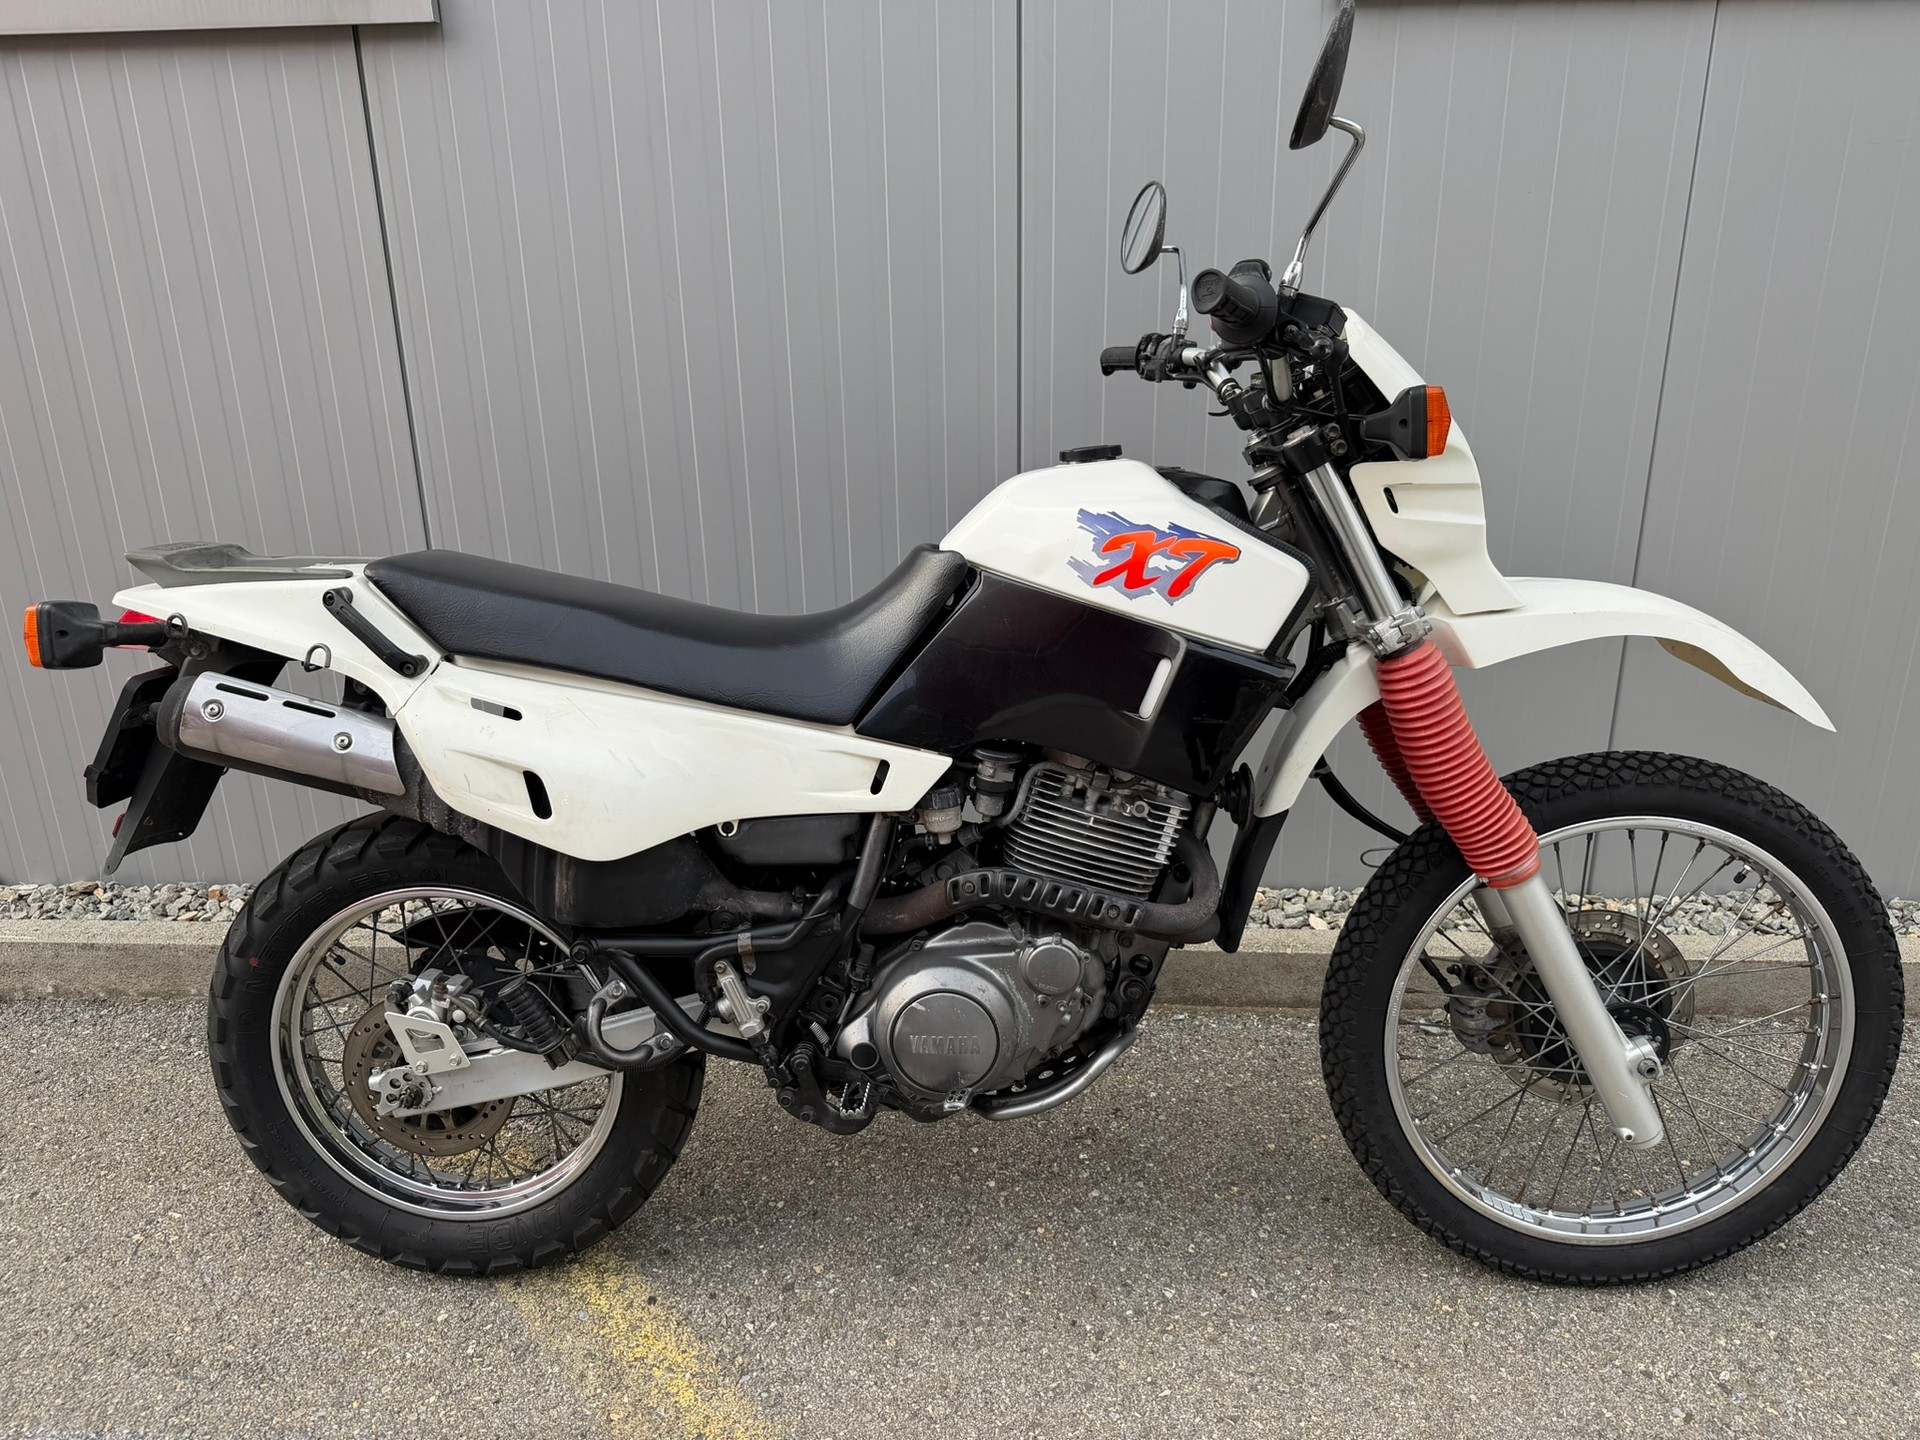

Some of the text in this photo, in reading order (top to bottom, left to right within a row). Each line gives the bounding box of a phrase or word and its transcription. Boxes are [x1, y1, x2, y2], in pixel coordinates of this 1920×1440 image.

[1092, 530, 1241, 599] XT
[243, 866, 401, 994] METZELER
[909, 1034, 981, 1055] YAMAHA
